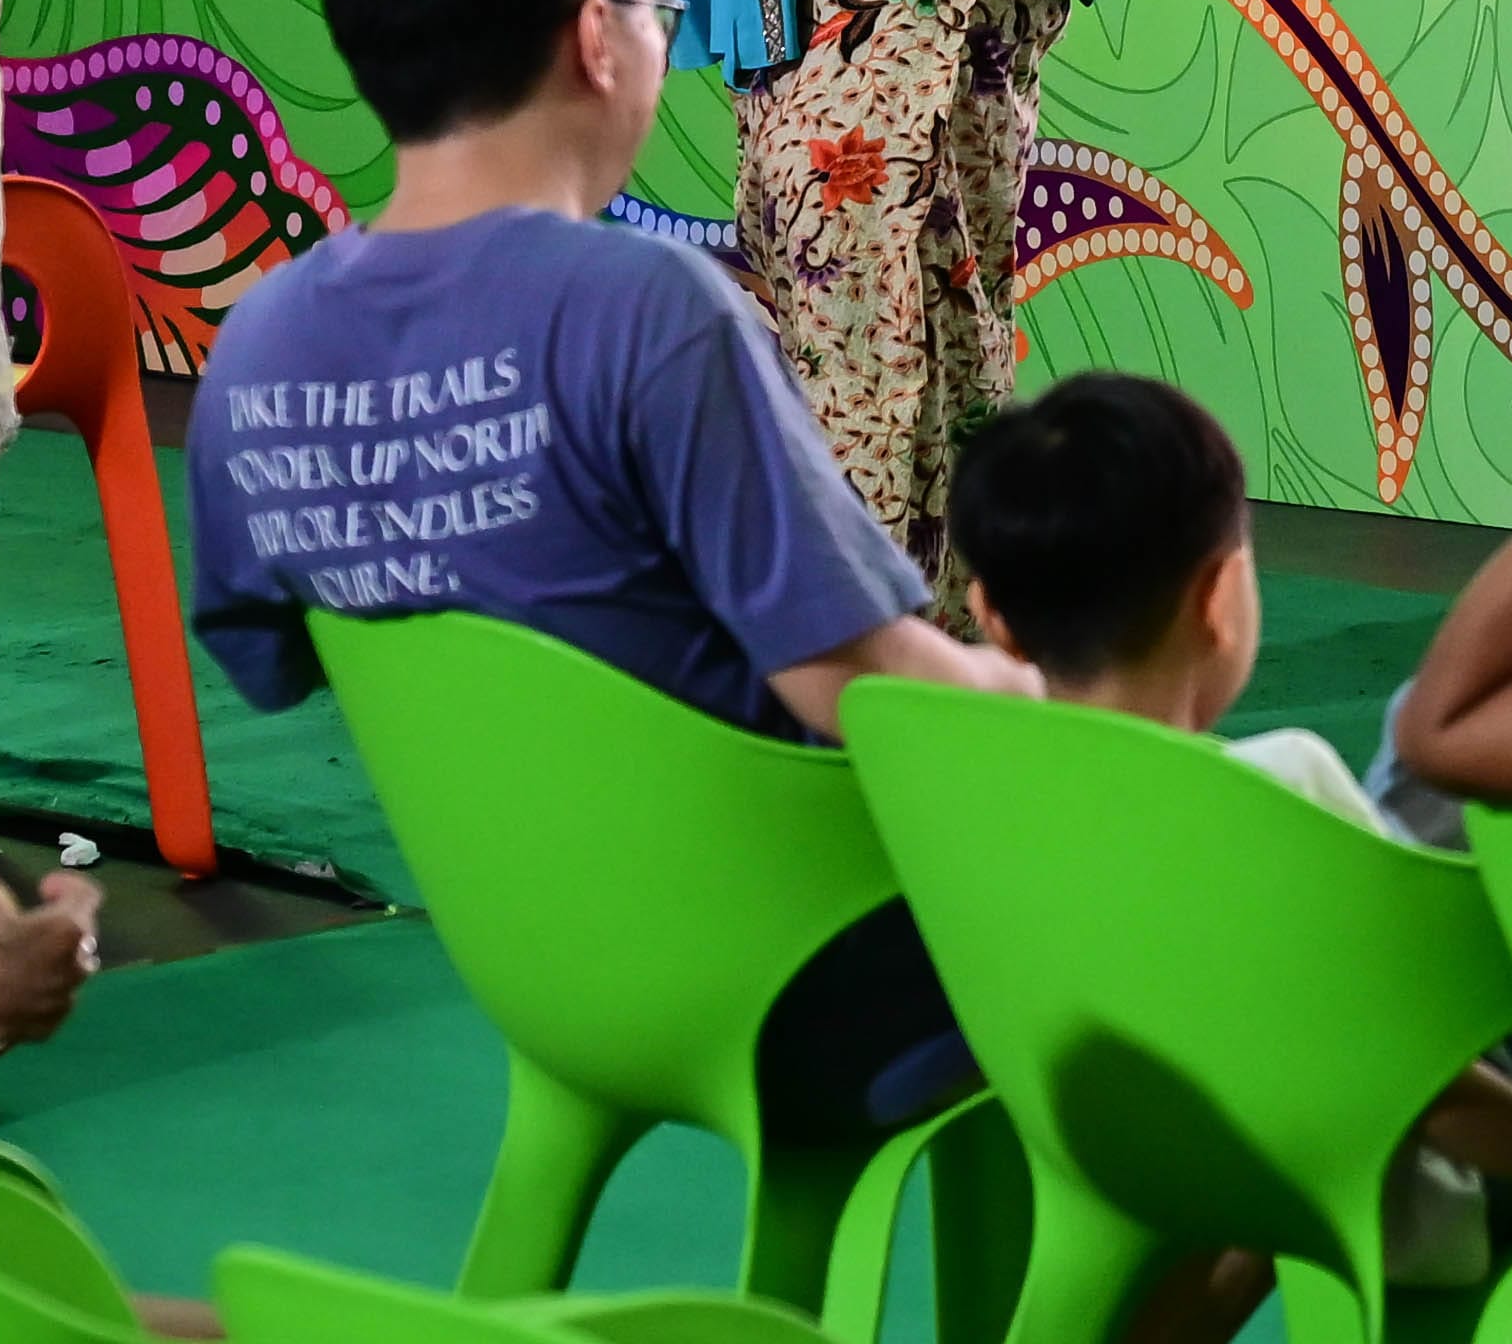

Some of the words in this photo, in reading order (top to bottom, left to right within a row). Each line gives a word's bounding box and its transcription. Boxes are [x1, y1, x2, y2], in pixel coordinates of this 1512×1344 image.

[297, 378, 379, 428] THE
[386, 347, 522, 421] TRAILS
[351, 438, 412, 486] UP
